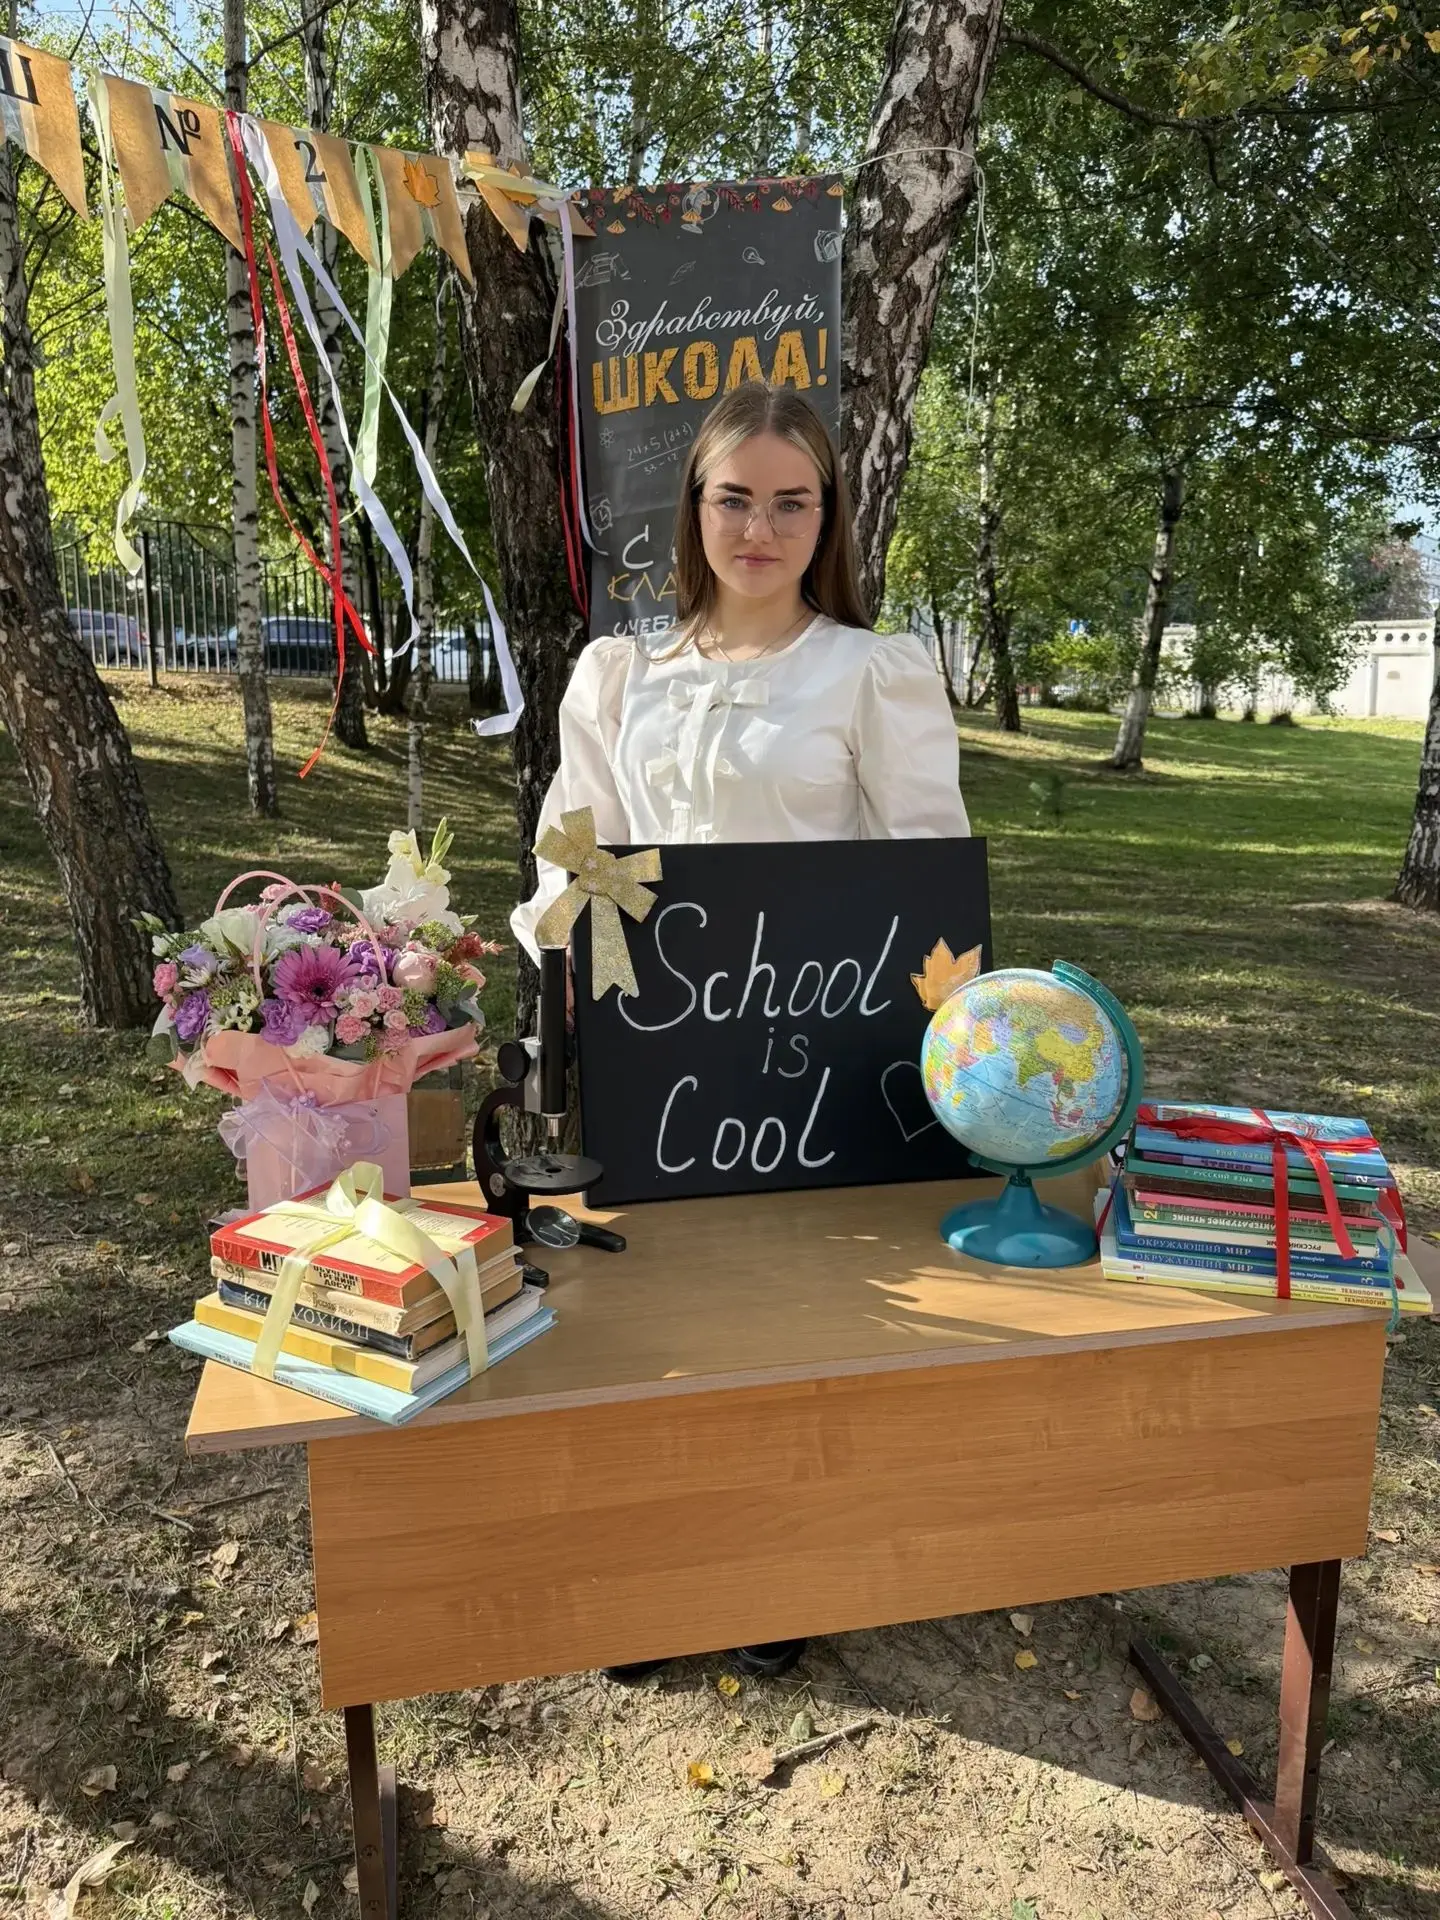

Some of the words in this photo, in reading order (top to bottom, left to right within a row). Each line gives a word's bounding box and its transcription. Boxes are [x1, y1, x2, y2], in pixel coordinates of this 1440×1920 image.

[295, 140, 327, 183] 2
[595, 288, 824, 358] Здравствуй,
[591, 328, 828, 416] ШКОЛА!
[607, 571, 677, 602] КЛА
[617, 902, 900, 1031] School
[761, 1027, 809, 1078] is
[656, 1067, 836, 1173] Cool
[1193, 1169, 1231, 1180] РУССКИЙ
[1143, 1209, 1159, 1220] 2
[1135, 1252, 1222, 1269] ОКРУЖАЮЩИЙ
[1226, 1262, 1254, 1272] МИР
[1136, 1239, 1222, 1254] ОКРУЖАЮЩИЙ
[1225, 1246, 1252, 1256] МИР
[324, 1279, 353, 1291] ДОСУГ
[1340, 1287, 1384, 1297] ТЕХНОЛОГИЯ
[243, 1291, 369, 1340] ПСИХОЛИЯ
[1344, 1296, 1387, 1306] ТЕХНОЛОГИЯ
